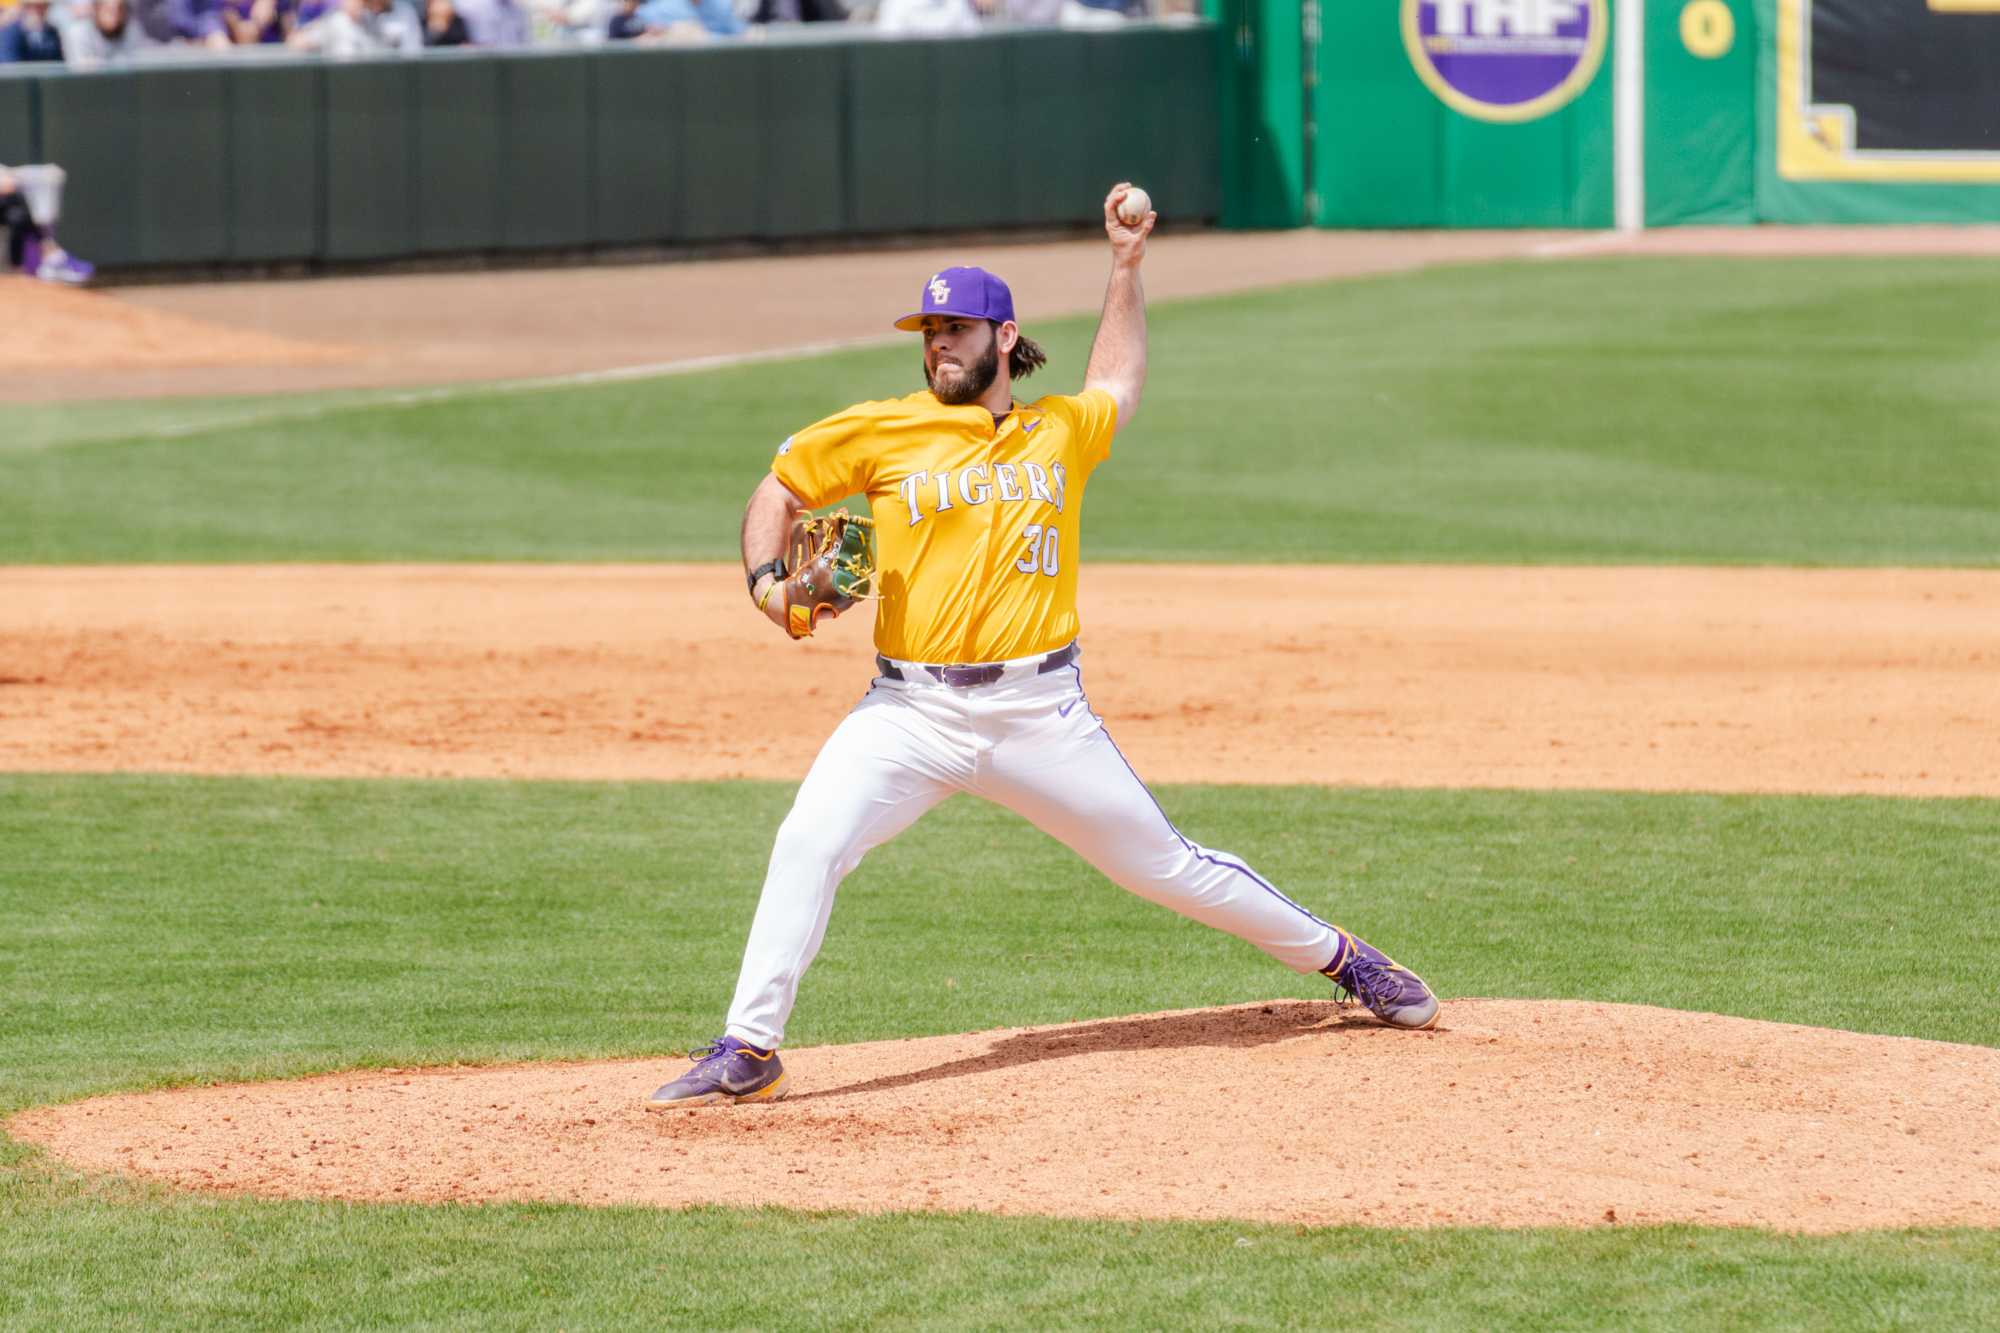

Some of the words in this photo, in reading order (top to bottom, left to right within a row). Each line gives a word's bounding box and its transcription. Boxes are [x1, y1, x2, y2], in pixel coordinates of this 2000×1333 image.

[928, 273, 951, 305] LSU
[899, 460, 1067, 527] TIGERS
[1016, 523, 1060, 577] 30
